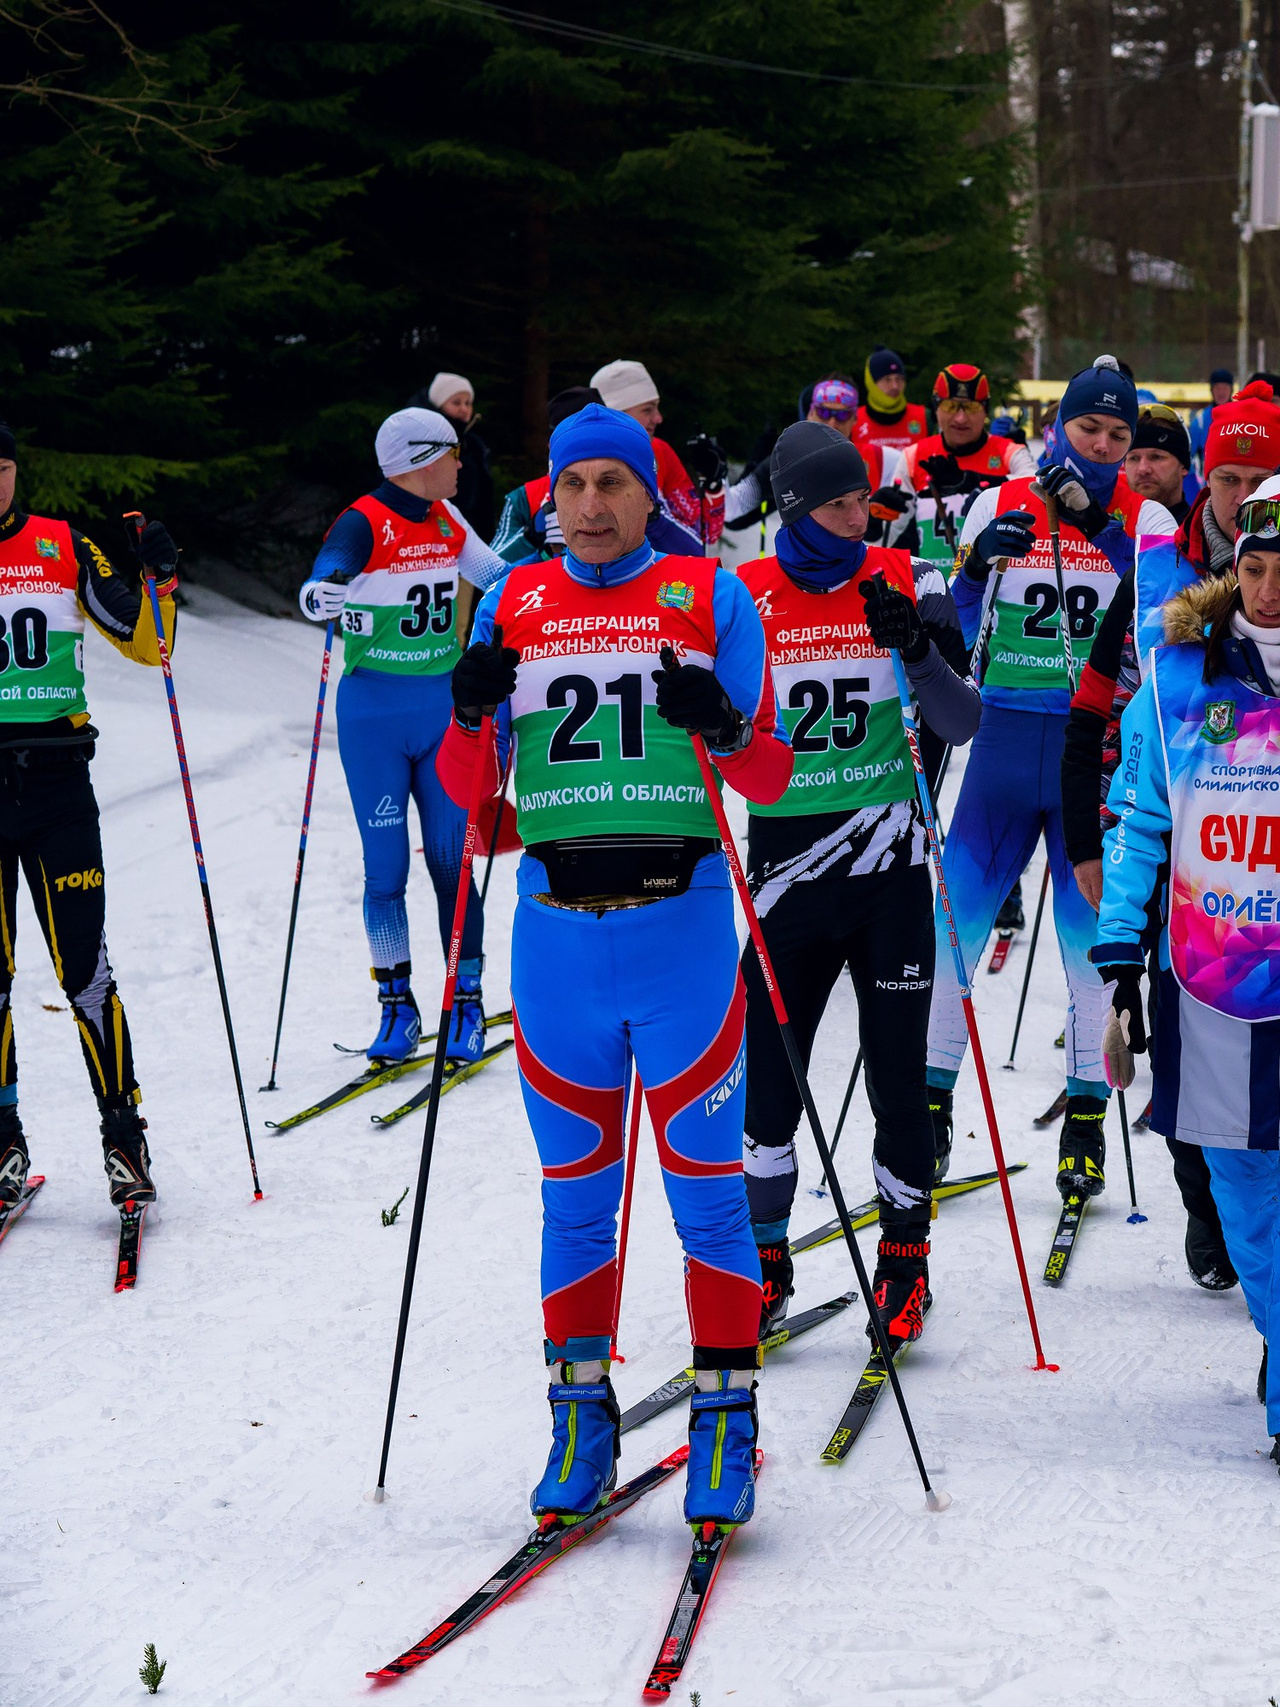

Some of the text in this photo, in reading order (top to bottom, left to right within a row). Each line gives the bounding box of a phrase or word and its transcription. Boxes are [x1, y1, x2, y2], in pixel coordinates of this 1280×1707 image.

[1220, 423, 1270, 439] LUKOIL
[1007, 524, 1026, 536] Sport
[81, 536, 113, 578] TOKO
[398, 543, 449, 558] ФЕДЕРАЦИЯ
[0, 565, 44, 579] РАЦИЯ
[388, 557, 434, 575] ЛЫЖНЫХ
[1074, 557, 1116, 573] ГОНО
[16, 581, 63, 595] ГОНОК
[399, 580, 455, 639] 35
[1022, 582, 1100, 641] 28
[344, 611, 364, 633] 35
[541, 615, 660, 636] ФЕДЕРАЦИЯ
[0, 606, 50, 674] 0
[520, 636, 687, 663] ЛЫЖНЫХ ГОНОК
[770, 645, 837, 666] ЫЖНЫХ
[27, 686, 77, 700] ОБЛАСТИ
[546, 672, 646, 765] 21
[788, 677, 871, 754] 25
[1124, 731, 1144, 786] 2023
[519, 782, 706, 813] КАЛУЖСКОЙ ОБЛАСТИ
[367, 815, 404, 829] Löffler
[463, 823, 477, 861] FORCE
[724, 841, 741, 879] FORCE
[925, 810, 958, 948] TEMPESTA
[448, 938, 460, 978] ROSSIGNOL
[757, 953, 774, 993] ROSSIGNOL
[1071, 1112, 1107, 1121] FISCHE
[558, 1388, 606, 1396] SPINE
[692, 1393, 740, 1405] SPINE
